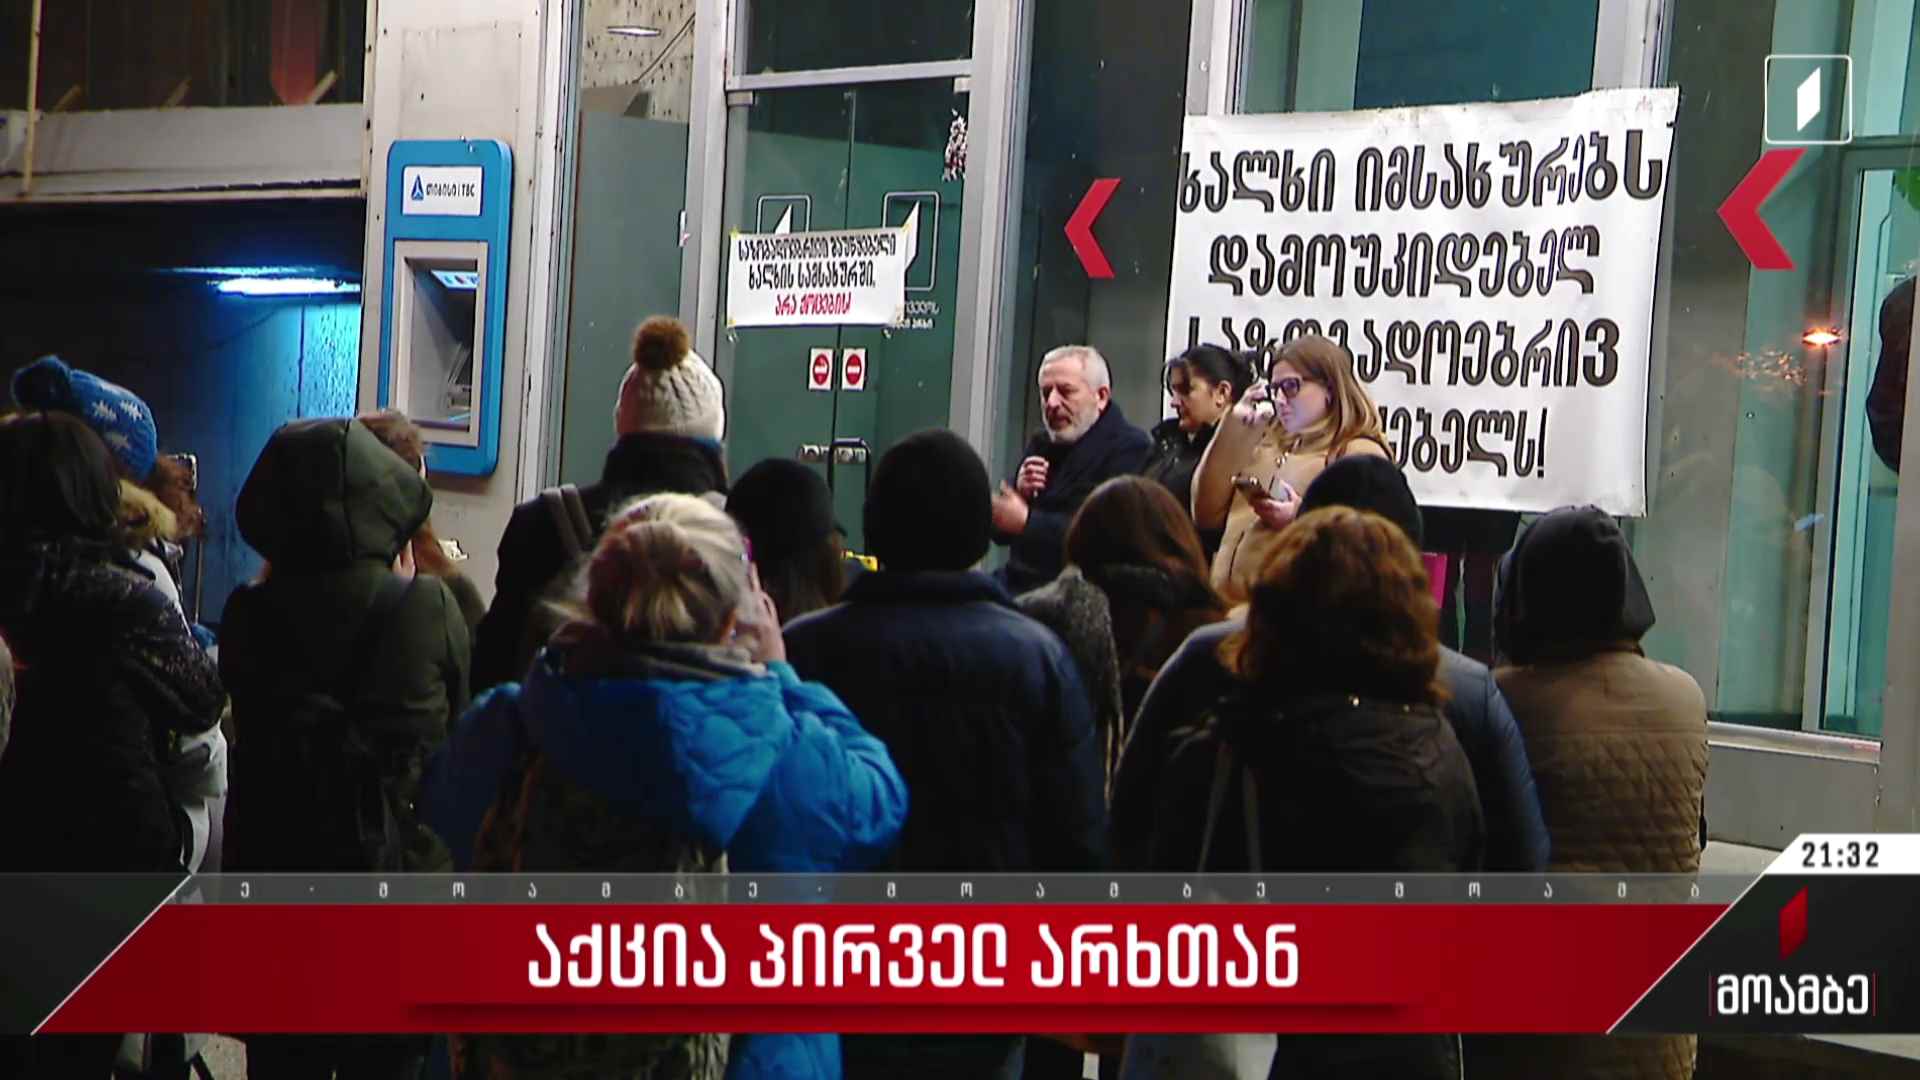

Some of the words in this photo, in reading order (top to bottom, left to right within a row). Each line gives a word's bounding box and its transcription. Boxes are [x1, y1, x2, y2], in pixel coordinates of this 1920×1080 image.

[462, 183, 475, 197] TBC
[1179, 147, 1336, 213] ხალხი
[1355, 129, 1663, 212] იმსახურებს
[1208, 224, 1601, 297] დამოუკიდებელ
[775, 295, 797, 316] არა
